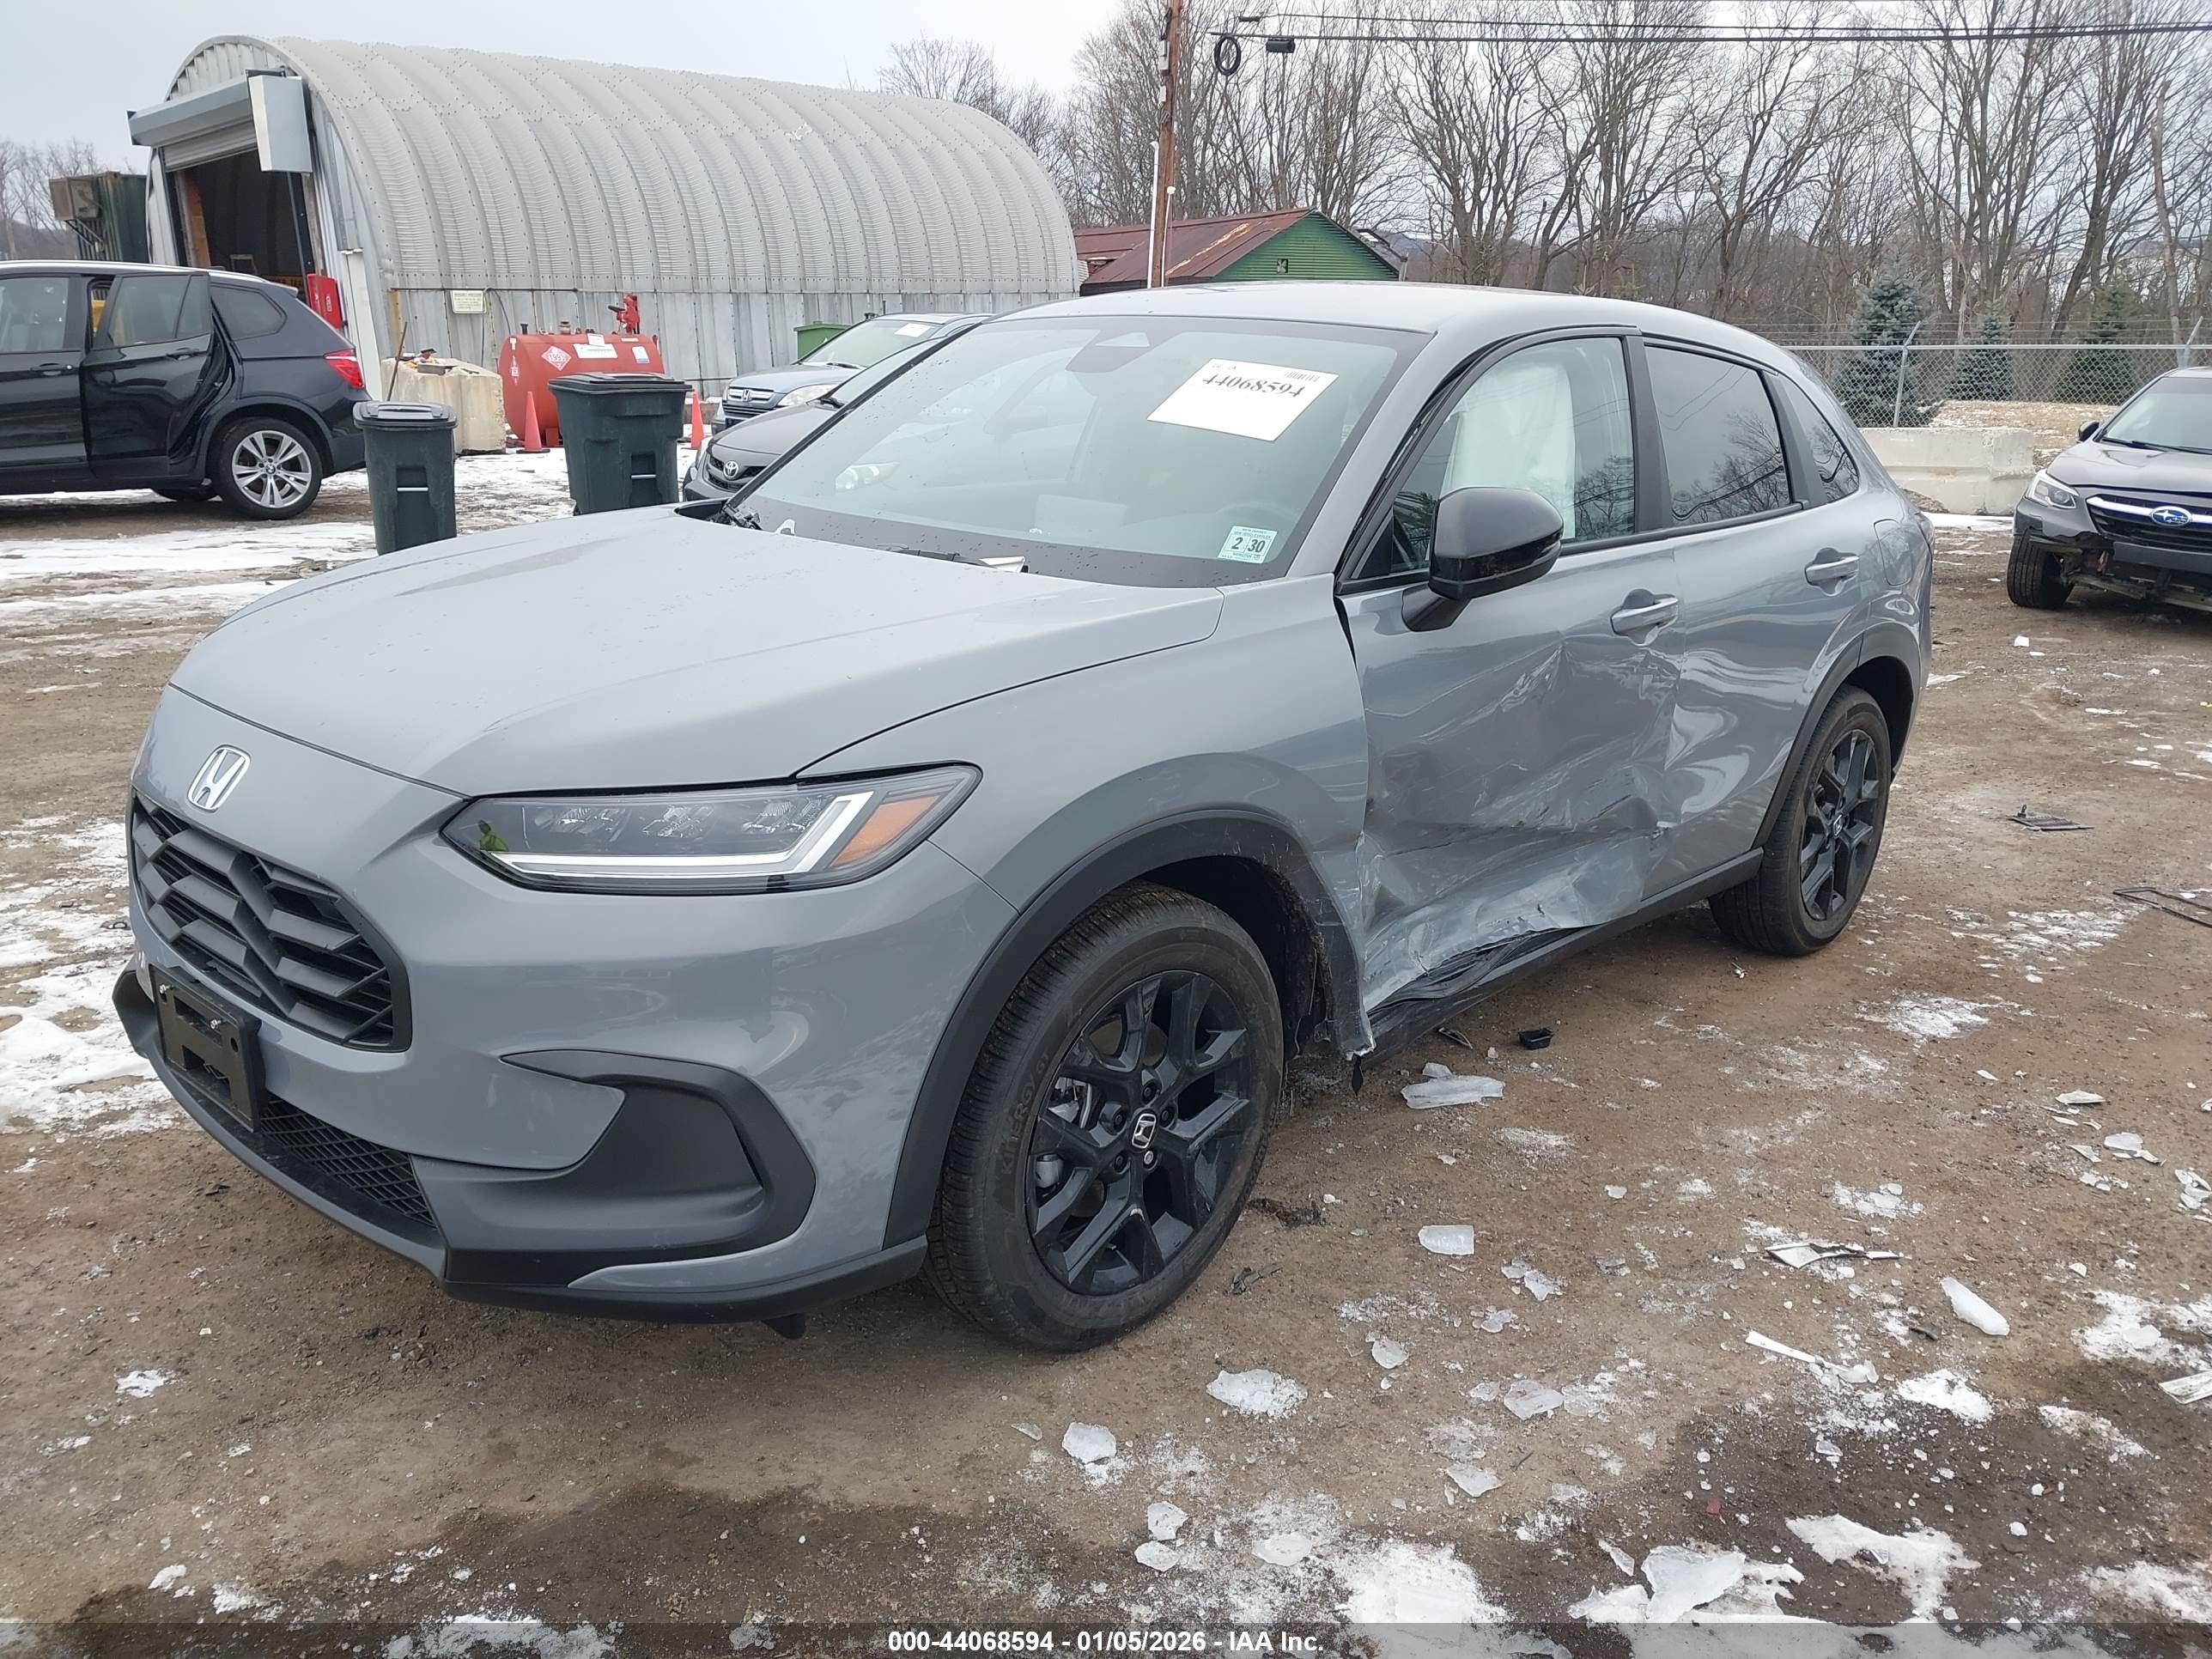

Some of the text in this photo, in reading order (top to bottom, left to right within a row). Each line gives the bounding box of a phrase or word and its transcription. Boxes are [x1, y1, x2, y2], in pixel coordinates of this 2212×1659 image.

[1202, 374, 1305, 398] 44068594
[1231, 537, 1266, 553] 2 30
[1001, 1071, 1036, 1176] KINERGY
